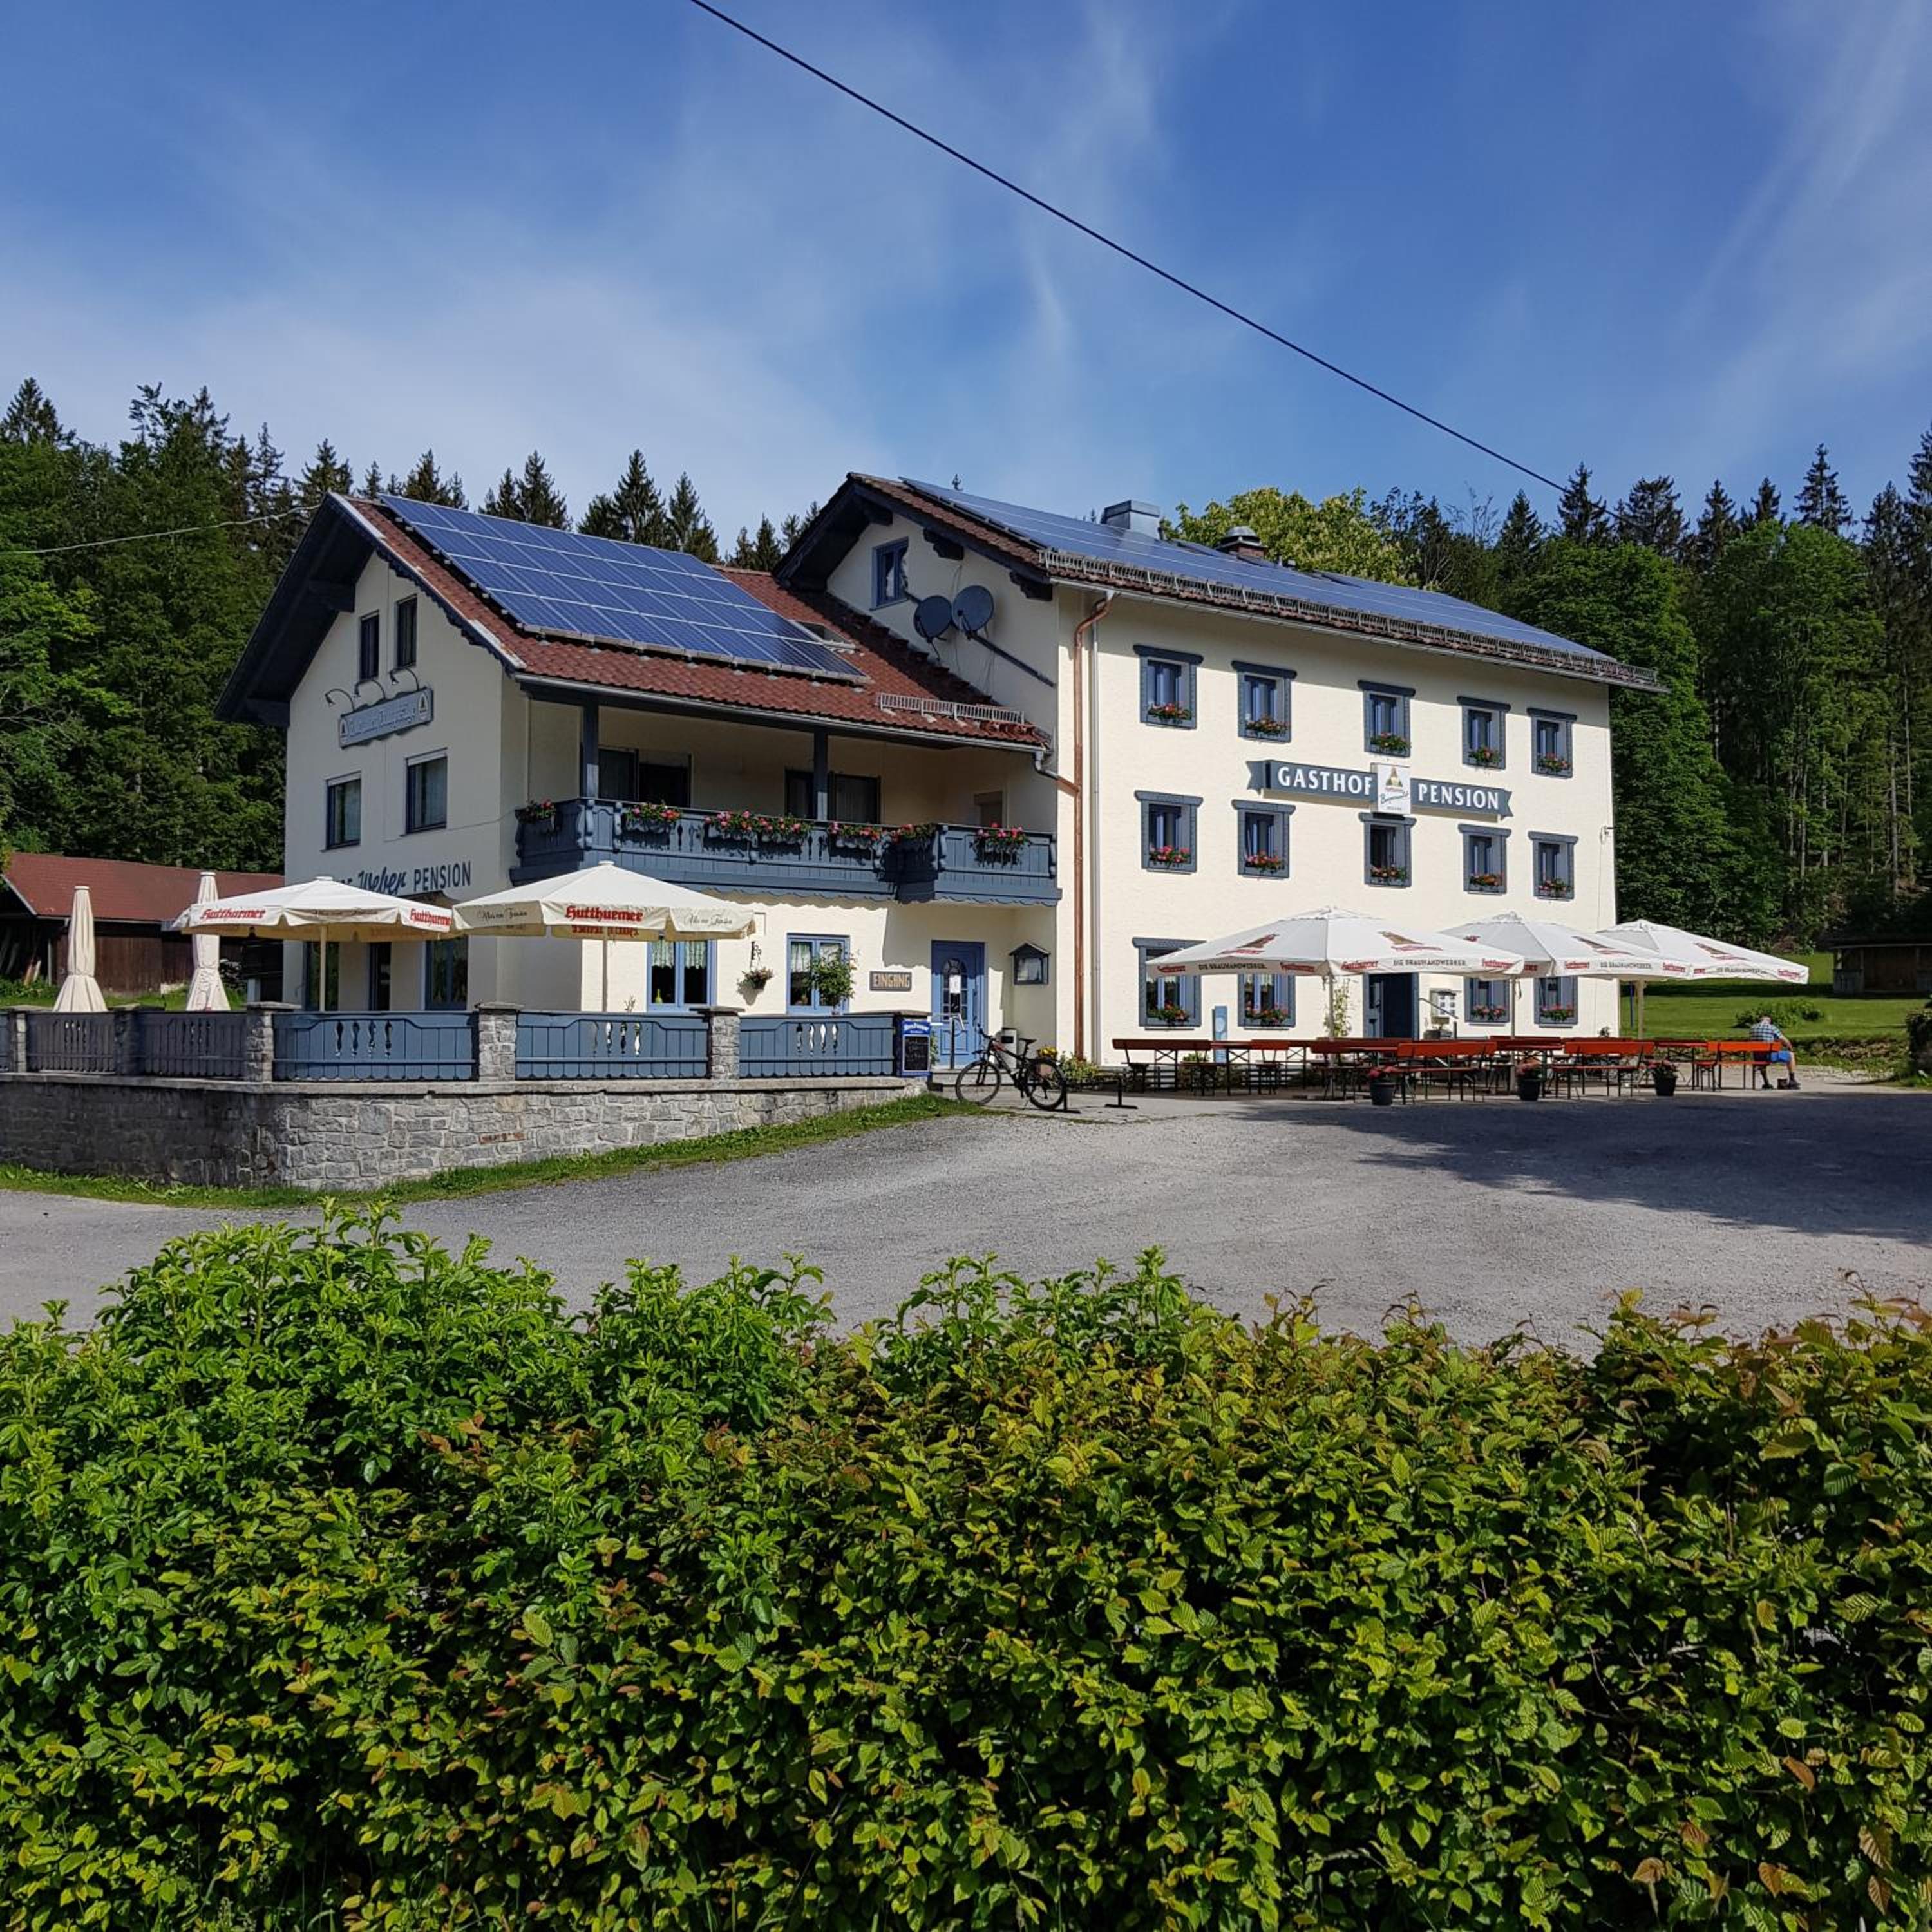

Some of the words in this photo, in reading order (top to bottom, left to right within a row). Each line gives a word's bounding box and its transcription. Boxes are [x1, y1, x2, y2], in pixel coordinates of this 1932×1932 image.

[1277, 766, 1373, 796] GASTHOF
[1417, 782, 1499, 810] PENSION
[413, 860, 471, 892] PENSION
[873, 972, 911, 989] EINGANG
